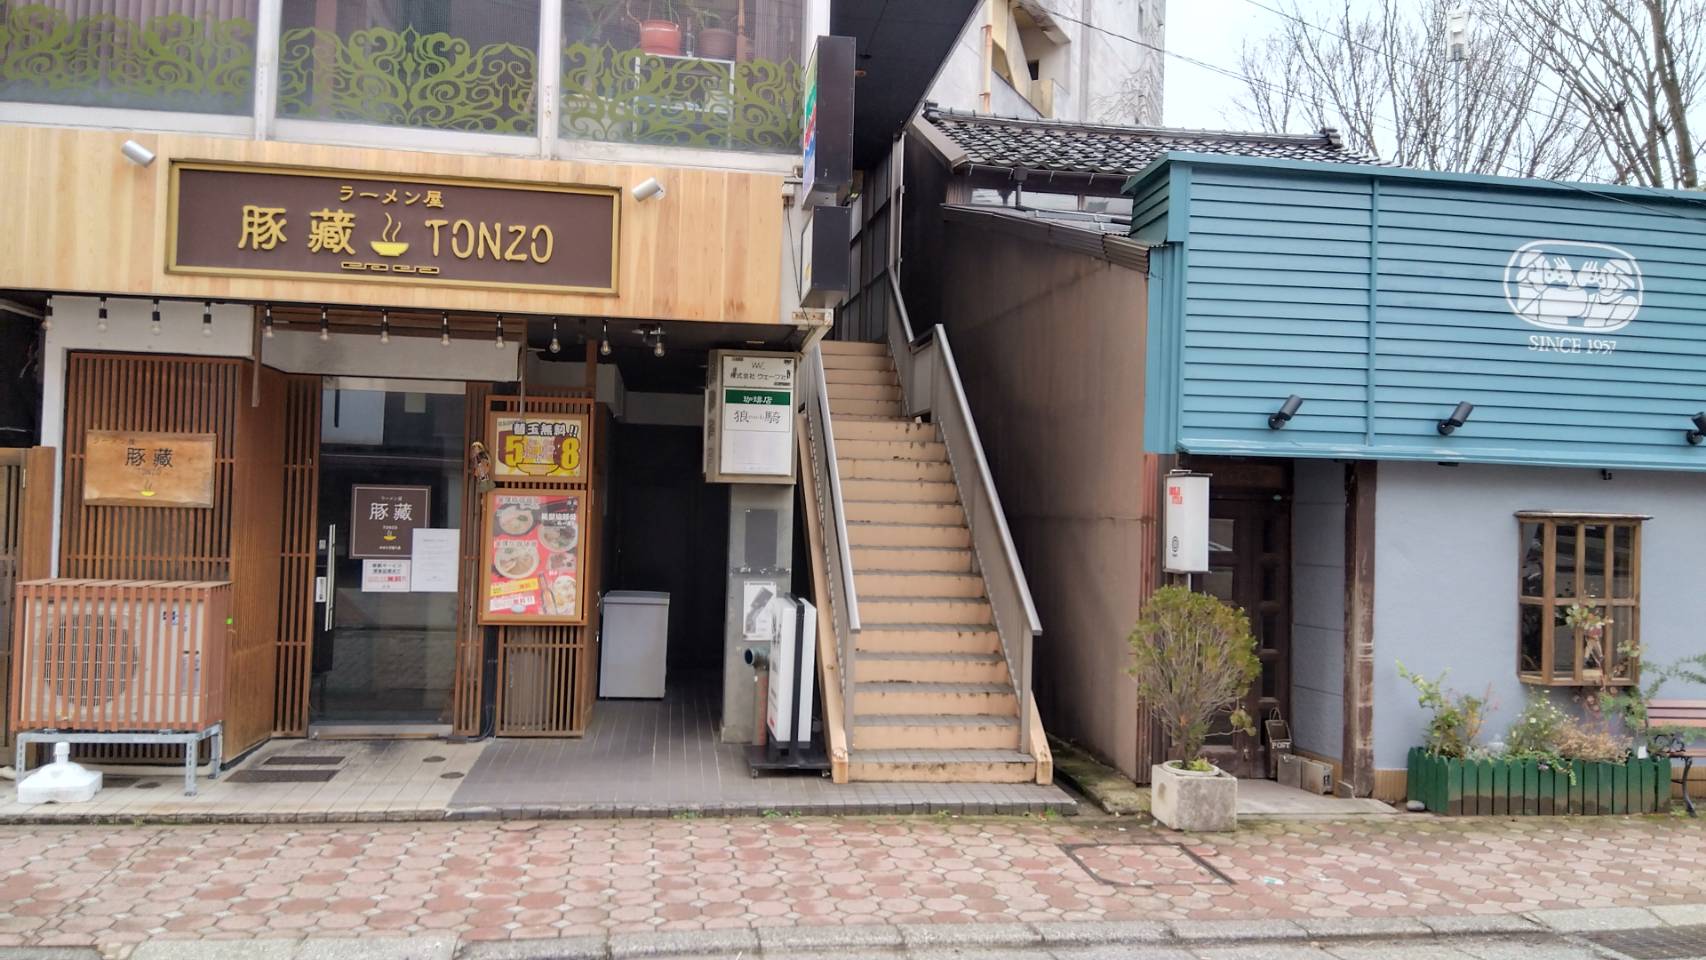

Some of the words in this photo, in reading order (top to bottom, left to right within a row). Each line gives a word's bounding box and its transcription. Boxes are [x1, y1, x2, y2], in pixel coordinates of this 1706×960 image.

[339, 185, 445, 209] ラーメン屋
[425, 219, 554, 265] TONZO
[1528, 335, 1582, 354] SINCE
[1586, 339, 1617, 355] 1957
[743, 395, 773, 405] 珈琲店
[1272, 741, 1291, 749] POST
